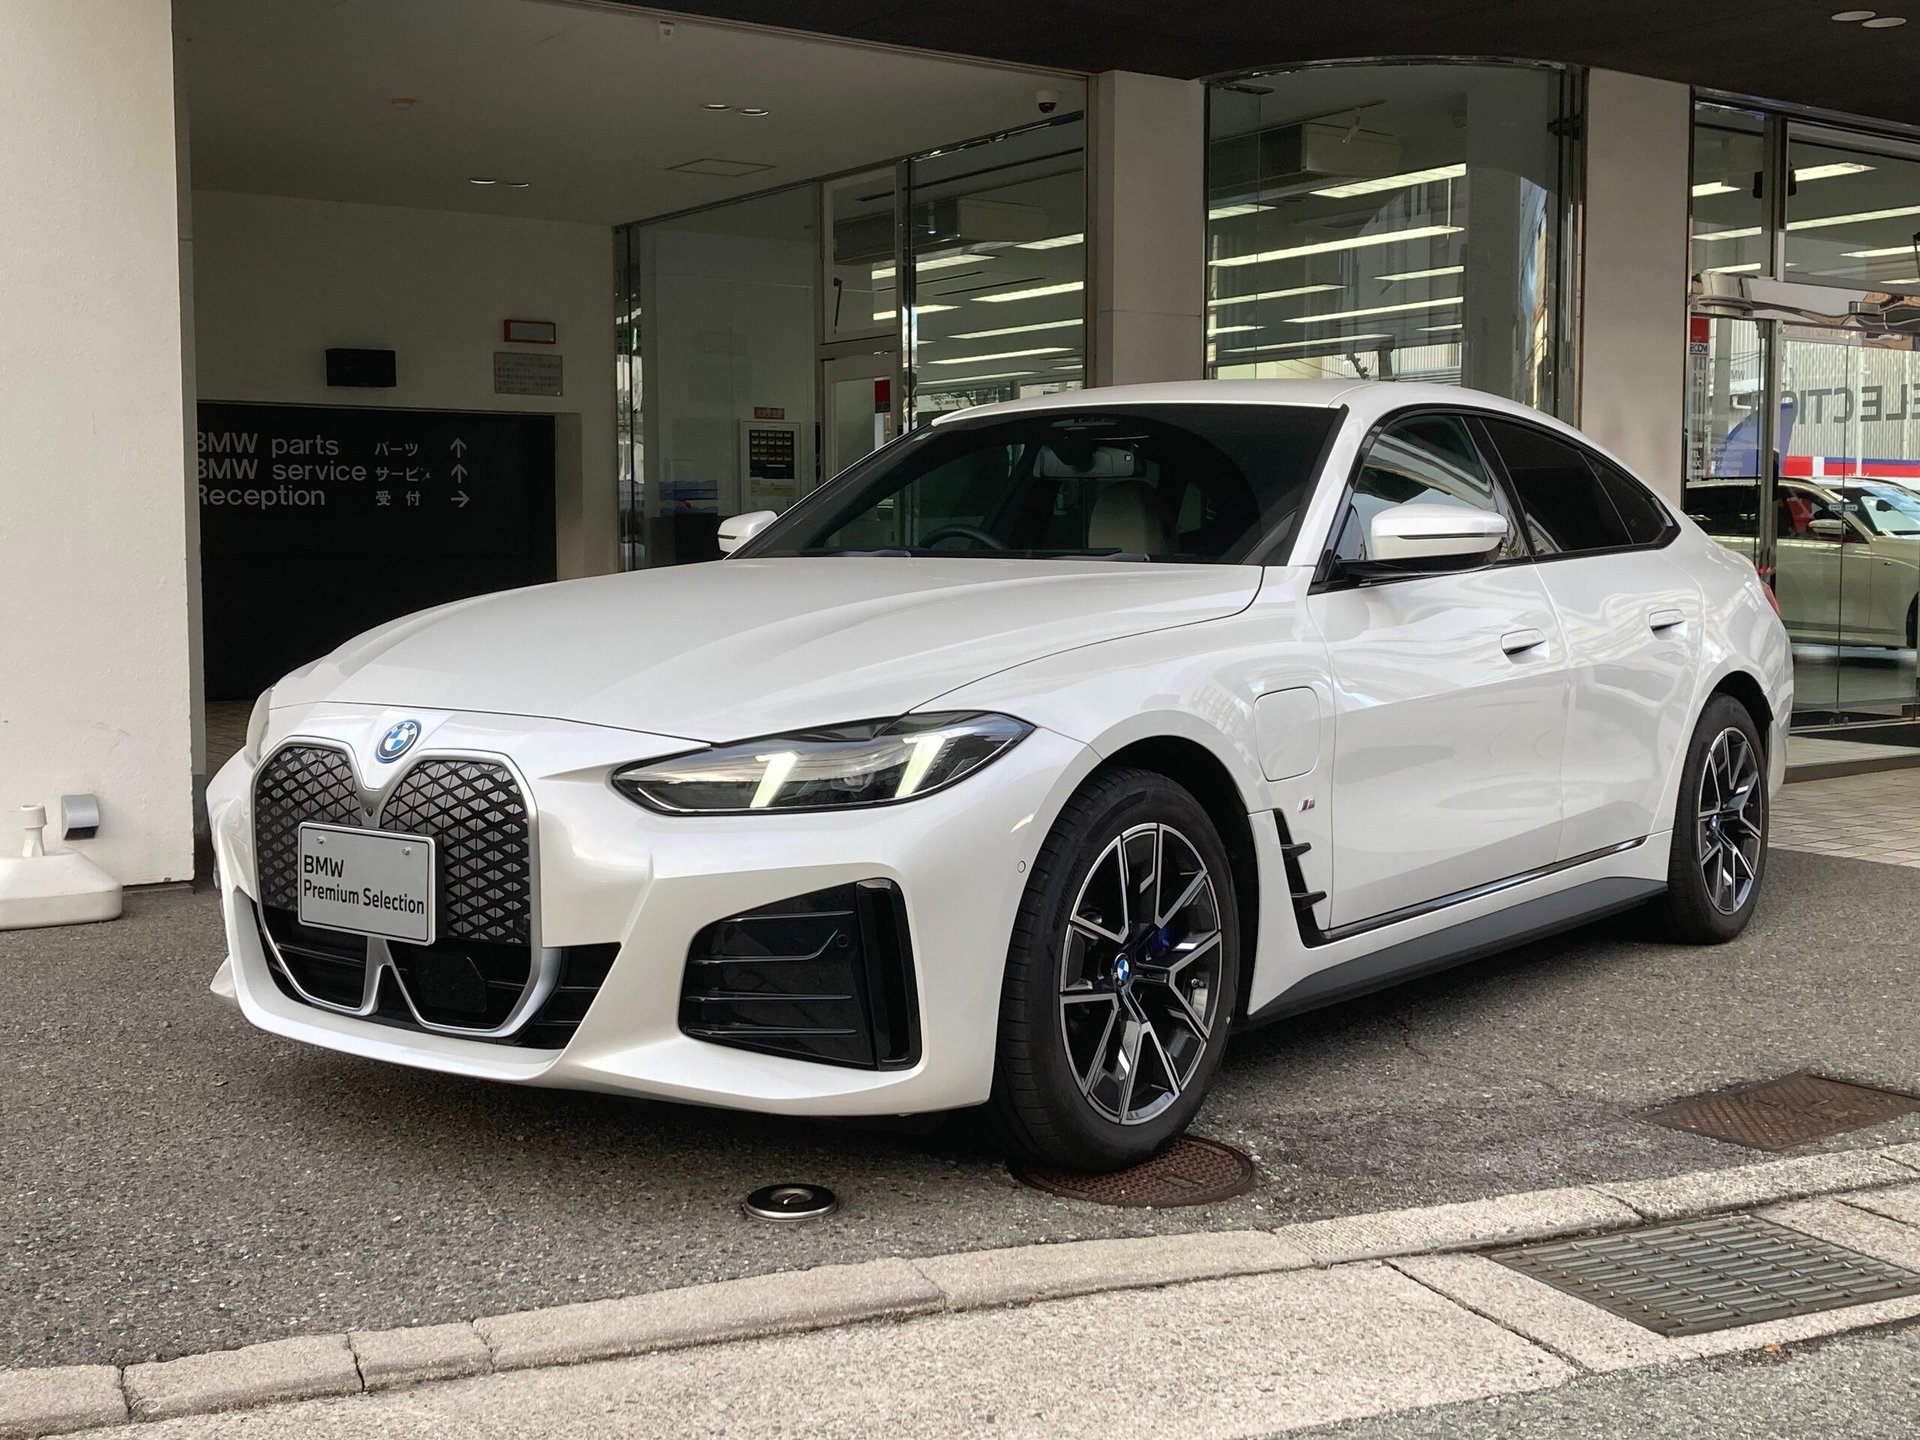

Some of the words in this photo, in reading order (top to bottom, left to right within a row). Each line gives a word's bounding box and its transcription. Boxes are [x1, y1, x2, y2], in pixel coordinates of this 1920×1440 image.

[198, 431, 258, 454] BMW
[271, 434, 340, 458] parts
[374, 441, 419, 457] パーツ
[198, 458, 259, 480] BMW
[272, 460, 367, 482] service
[198, 484, 326, 510] Reception
[304, 854, 344, 878] BMW
[304, 879, 360, 905] Premium
[363, 887, 425, 915] Selection
